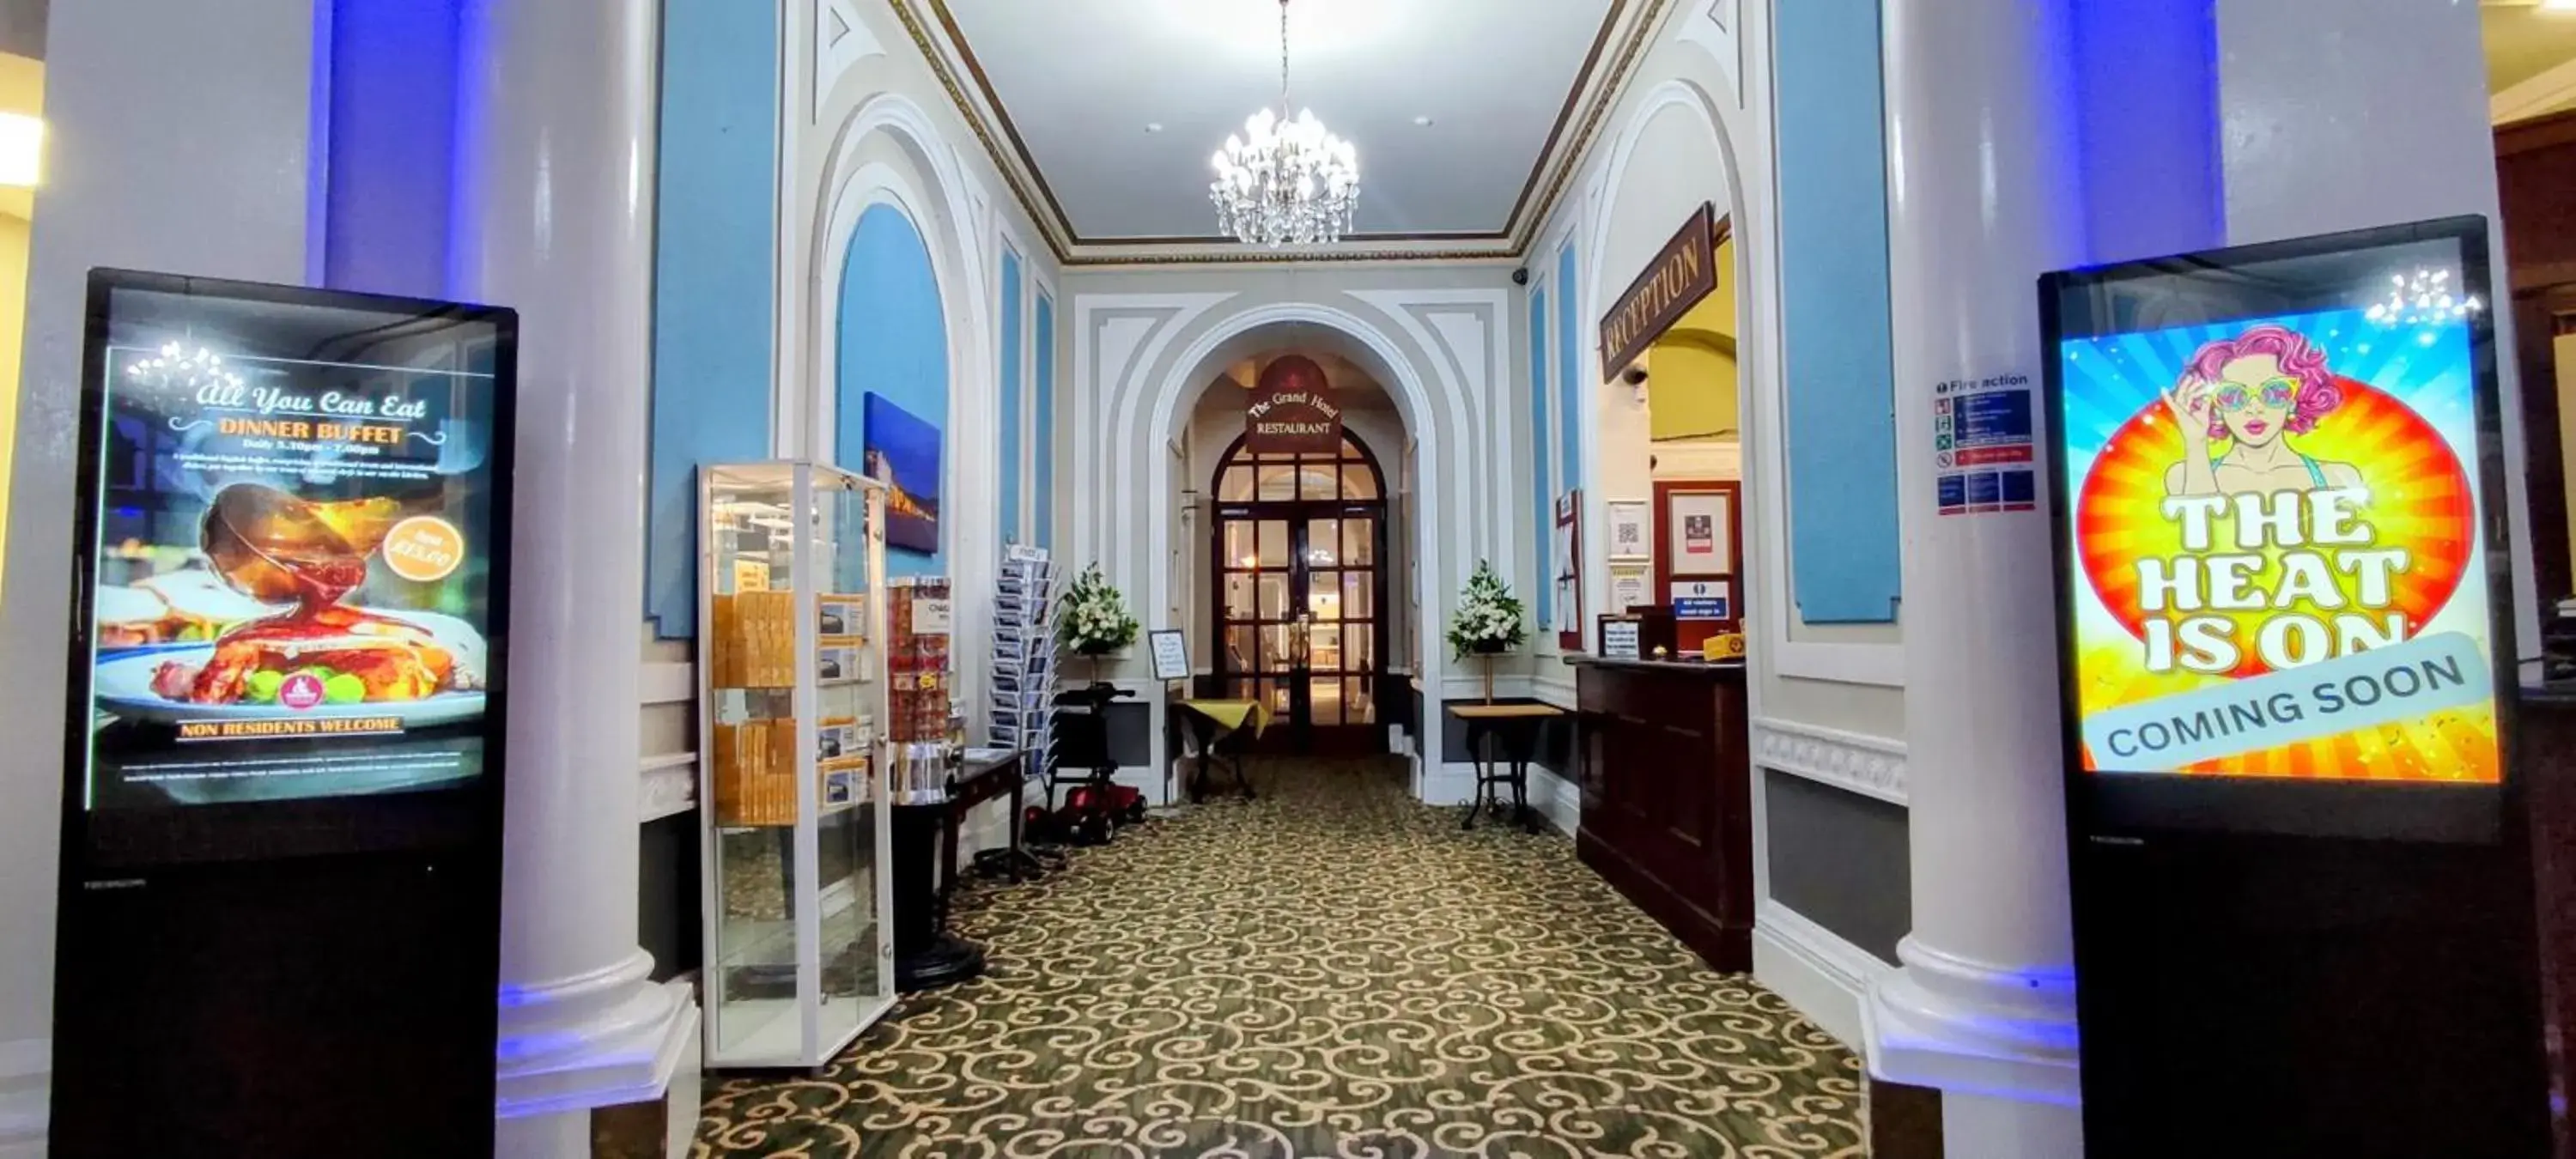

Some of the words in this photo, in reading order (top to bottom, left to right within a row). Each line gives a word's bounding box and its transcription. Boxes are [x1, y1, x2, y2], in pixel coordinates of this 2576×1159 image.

[1606, 236, 1699, 361] RECEPTION
[197, 379, 245, 406] All
[252, 386, 313, 415] You
[319, 391, 374, 414] Can
[380, 396, 427, 418] Eat
[1950, 379, 1978, 391] Fire
[1983, 374, 2028, 388] action
[1248, 401, 1271, 418] The
[1272, 392, 1308, 404] Grand
[1310, 394, 1340, 420] Hotel
[219, 417, 309, 439] DINNER
[317, 422, 404, 444] BUFFET
[1256, 422, 1331, 434] RESTAURANT
[242, 439, 274, 451] Daily
[2160, 487, 2375, 552] THE
[2136, 547, 2411, 612] HEAT
[2143, 614, 2241, 675] IS
[2256, 611, 2407, 671] ON
[2107, 692, 2304, 758] COMING
[2312, 655, 2465, 713] SOON
[180, 724, 219, 737] NON
[222, 720, 315, 736] RESIDENTS
[320, 717, 400, 732] WELCOME
